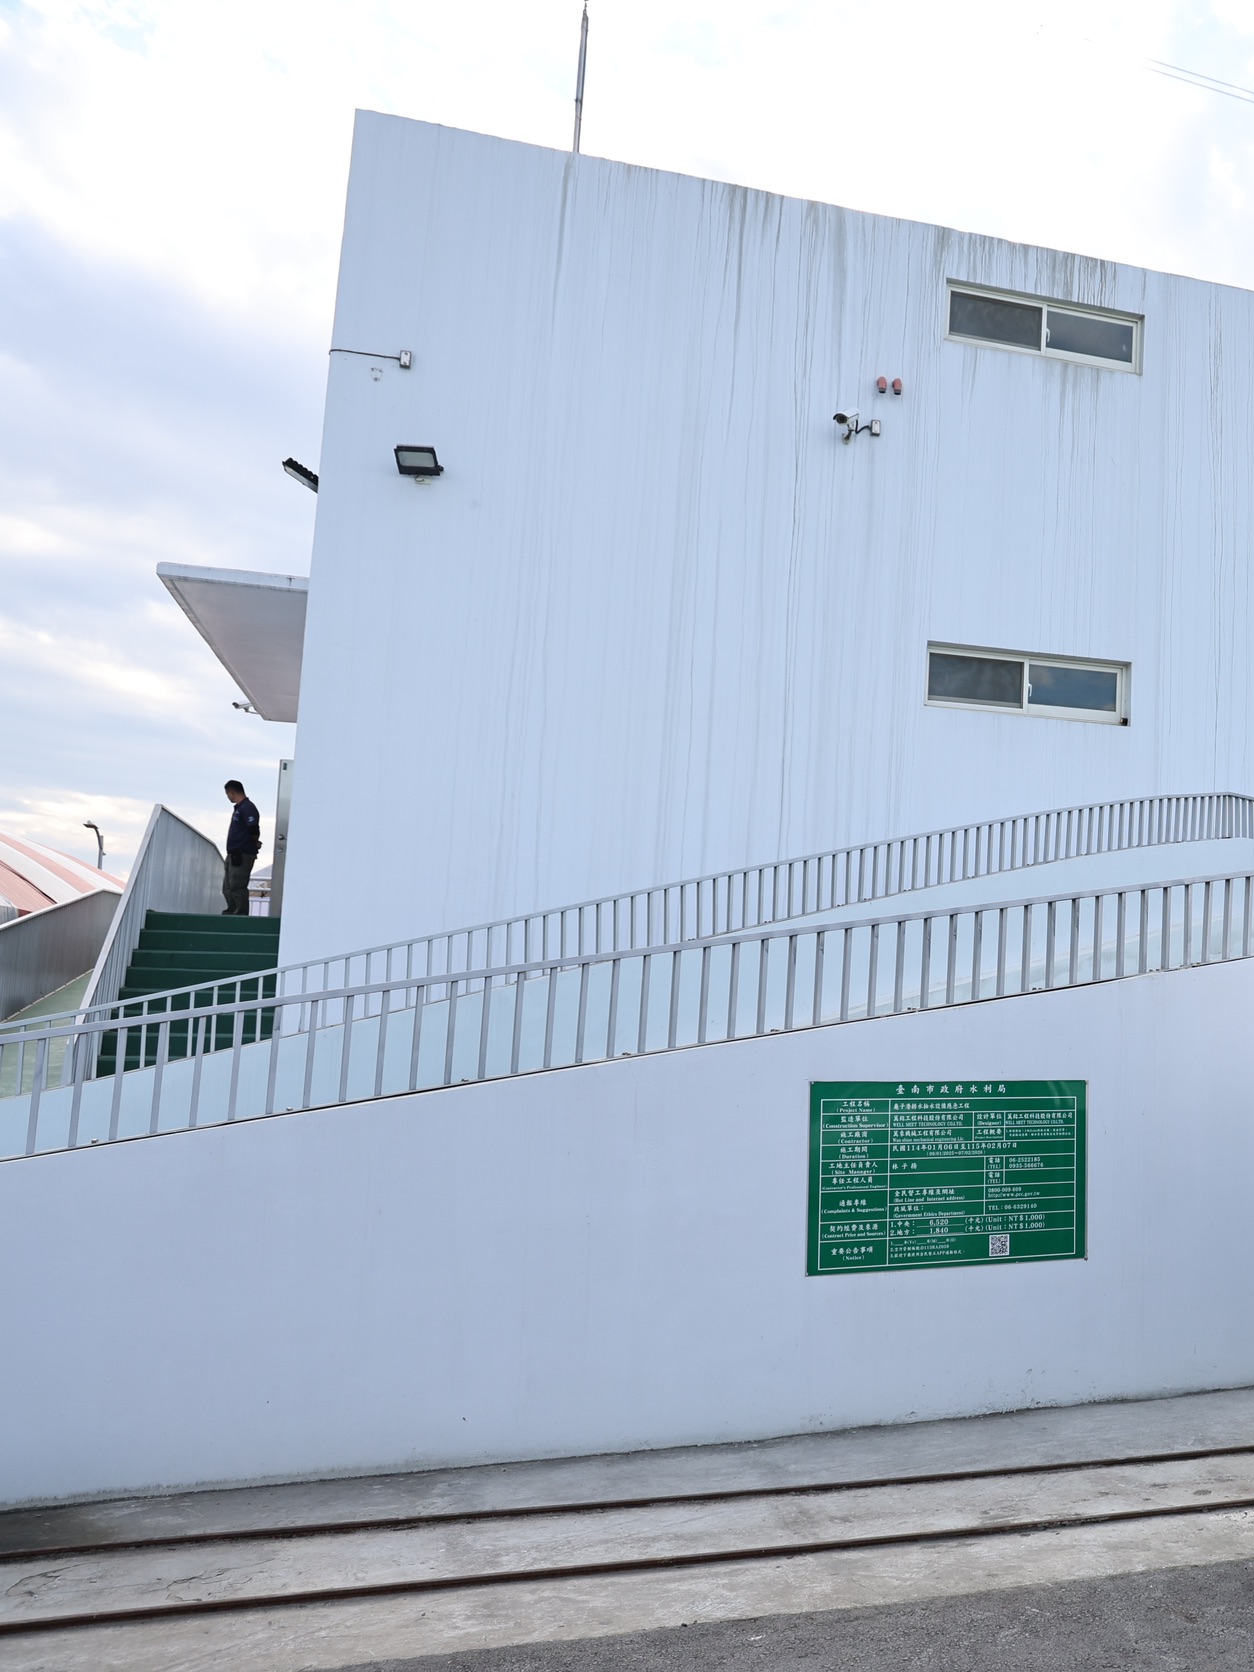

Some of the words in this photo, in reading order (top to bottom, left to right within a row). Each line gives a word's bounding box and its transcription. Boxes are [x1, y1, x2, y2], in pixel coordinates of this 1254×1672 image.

[895, 1084, 1007, 1095] 臺南市政府水利局
[893, 1142, 1017, 1152] 民國114年01月06日至115年02月07日
[829, 1161, 878, 1169] 工地主任負責人
[831, 1176, 873, 1185] 專任工程人員
[894, 1188, 955, 1197] 全民督工專線及網址
[839, 1199, 867, 1207] 通報專線
[830, 1224, 878, 1233] 契約經費及來源
[831, 1246, 873, 1256] 重要公告事項
